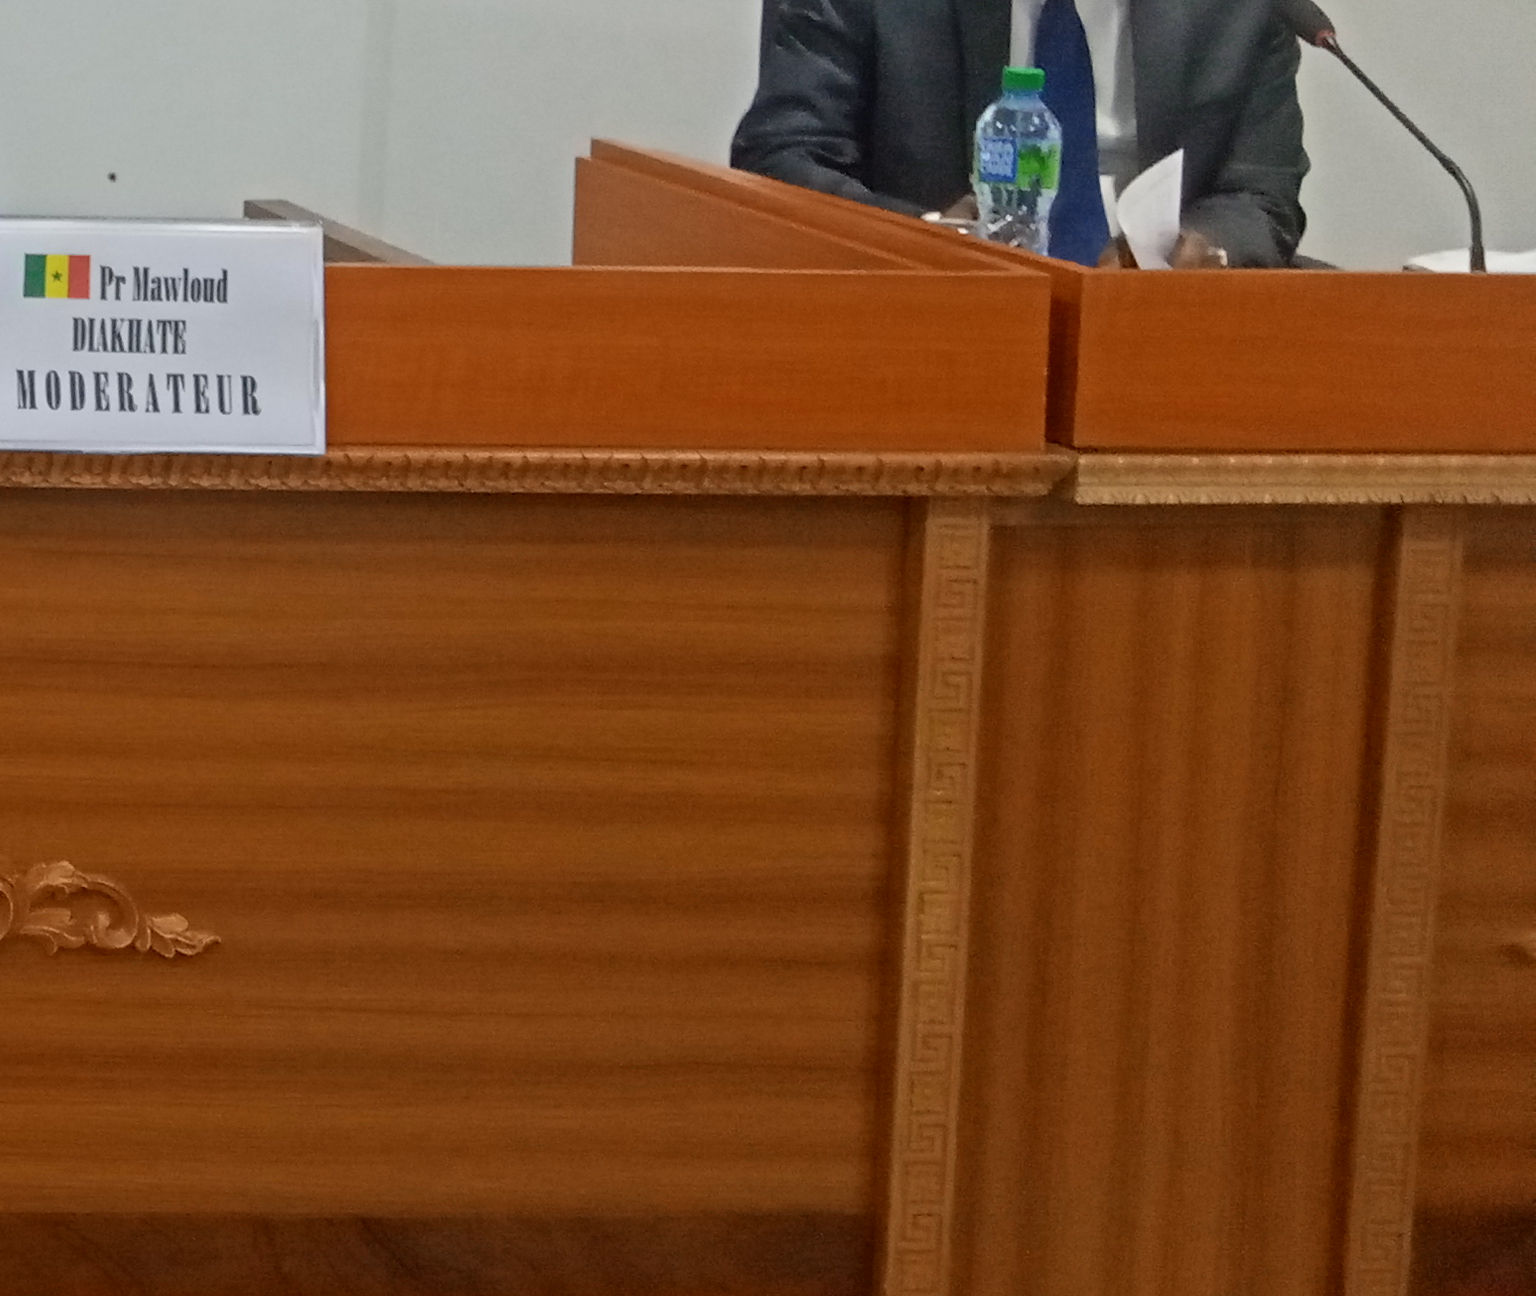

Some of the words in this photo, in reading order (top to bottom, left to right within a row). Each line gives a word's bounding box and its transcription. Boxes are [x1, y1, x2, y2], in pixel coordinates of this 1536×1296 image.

[99, 265, 127, 301] Pr
[132, 266, 228, 304] Mawloud
[72, 317, 187, 355] DIAKHATE
[15, 369, 262, 416] MODERATEUR
